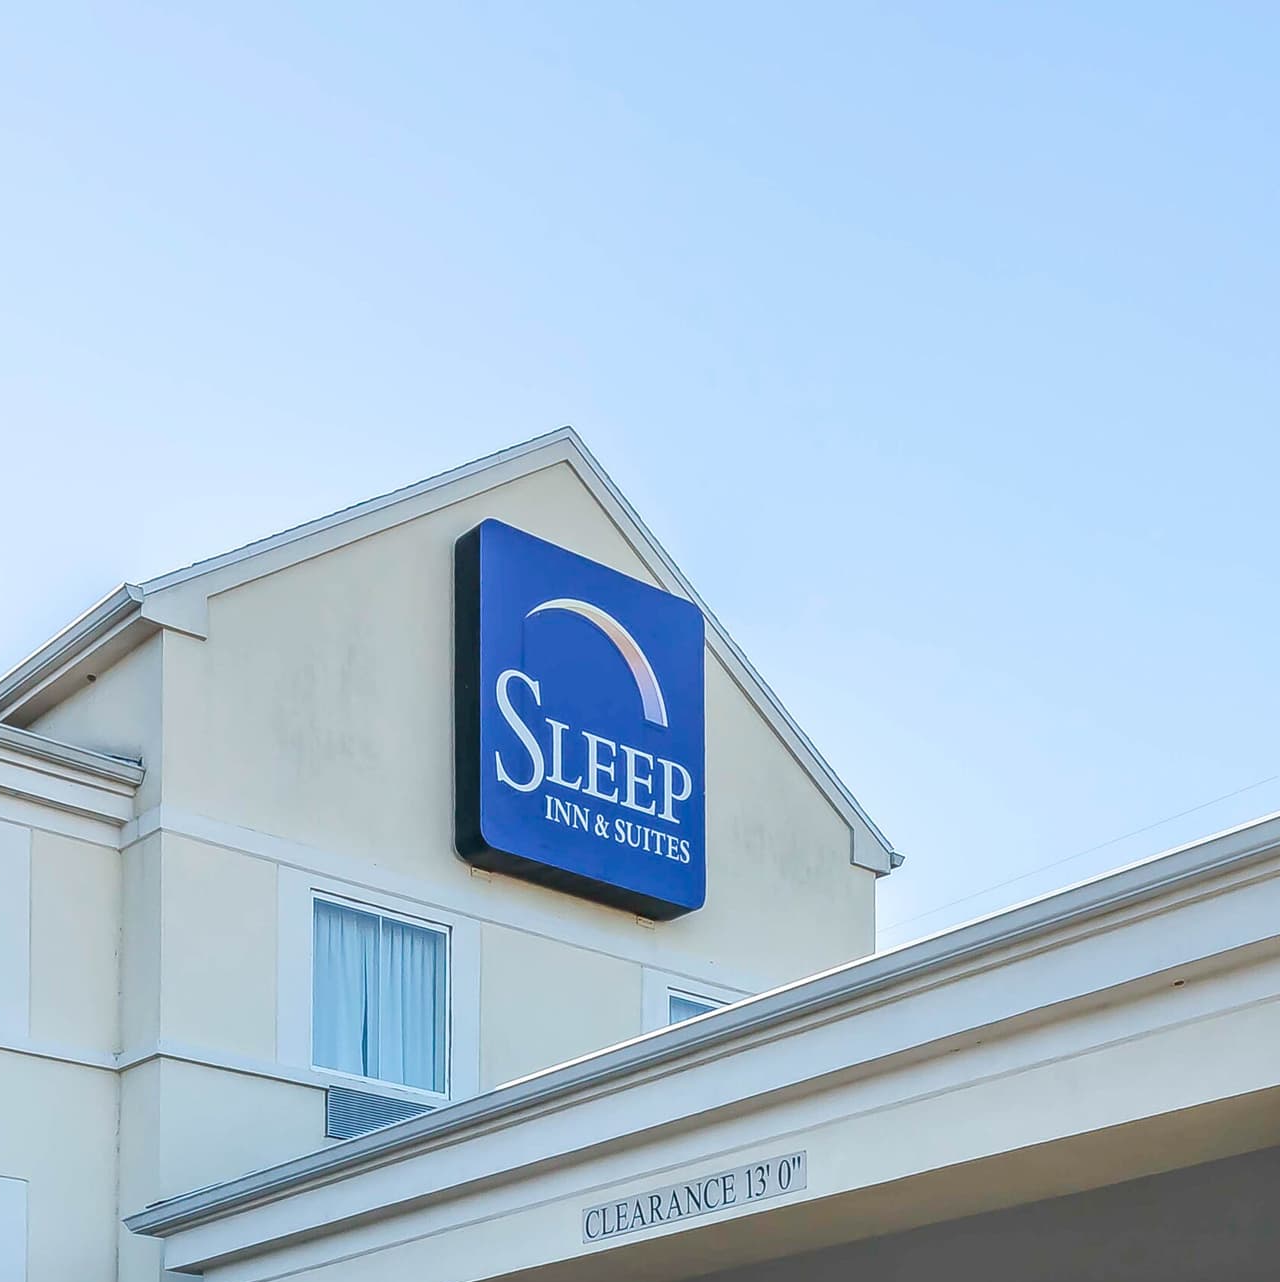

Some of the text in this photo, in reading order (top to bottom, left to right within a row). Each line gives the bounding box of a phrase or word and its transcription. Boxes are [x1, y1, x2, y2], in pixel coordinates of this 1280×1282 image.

[545, 795, 690, 864] INN & SUITES
[585, 1174, 736, 1239] CLEARANCE
[745, 1164, 770, 1199] 13'
